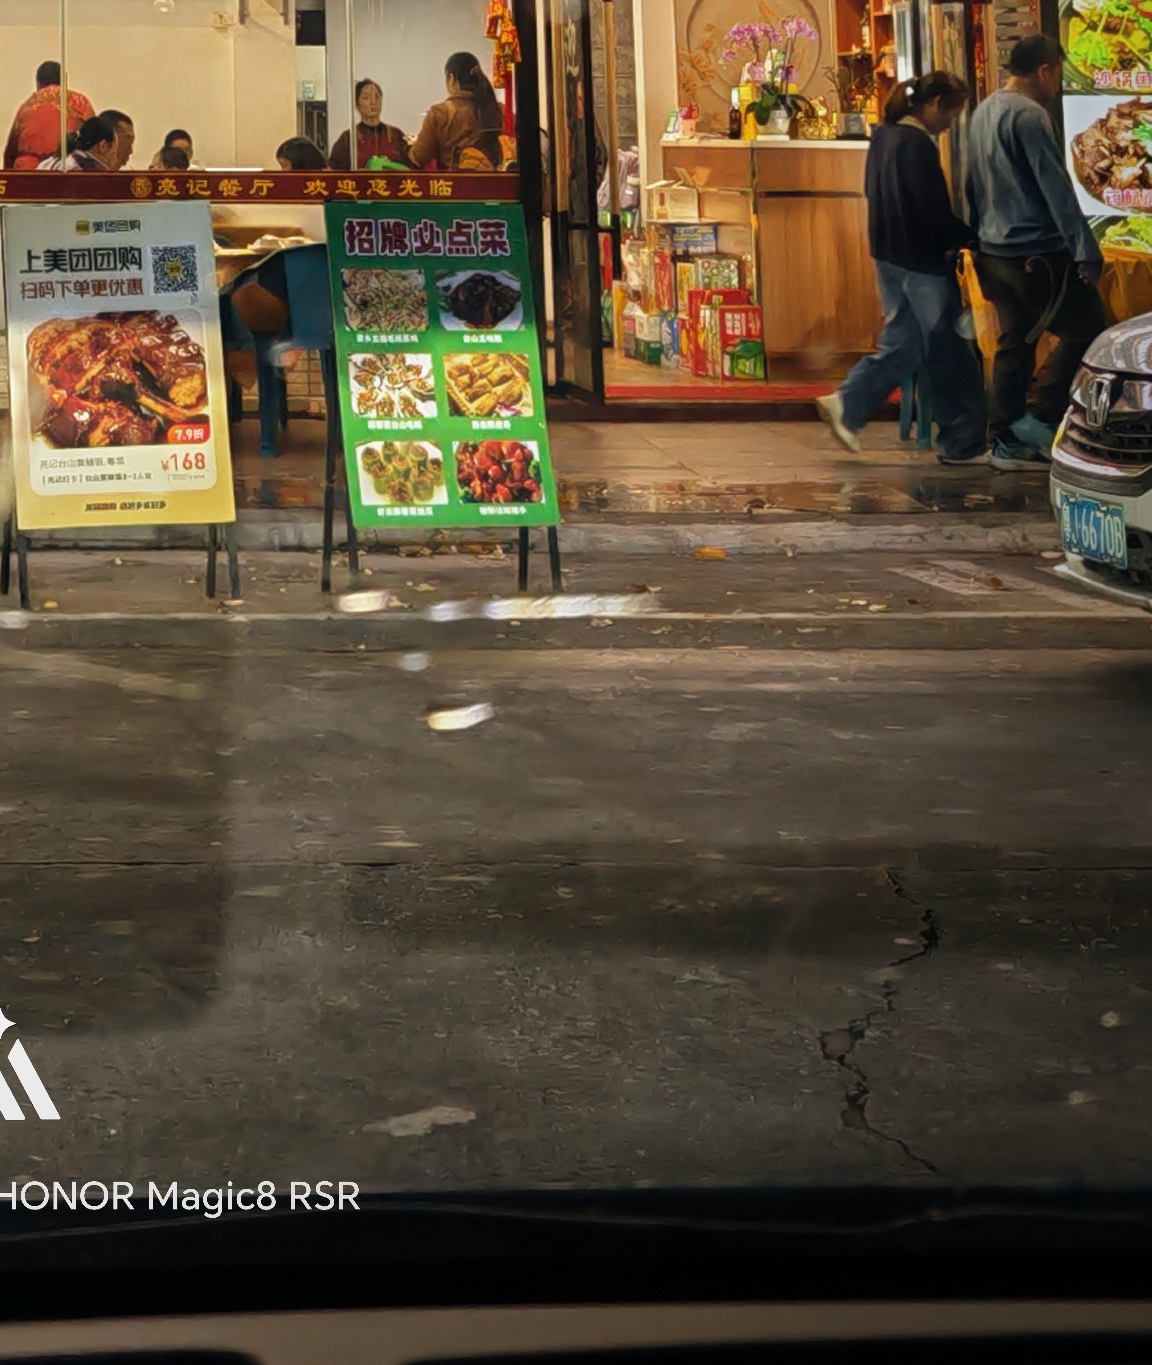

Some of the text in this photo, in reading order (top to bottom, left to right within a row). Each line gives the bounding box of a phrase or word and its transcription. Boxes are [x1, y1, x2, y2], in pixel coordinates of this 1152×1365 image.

[155, 177, 454, 197] 亮记餐厅 欢迎您光临
[344, 218, 510, 256] 招牌必点菜
[19, 246, 142, 274] 上美团团购
[19, 278, 144, 301] 扫码下单更优惠
[160, 452, 206, 472] ¥168
